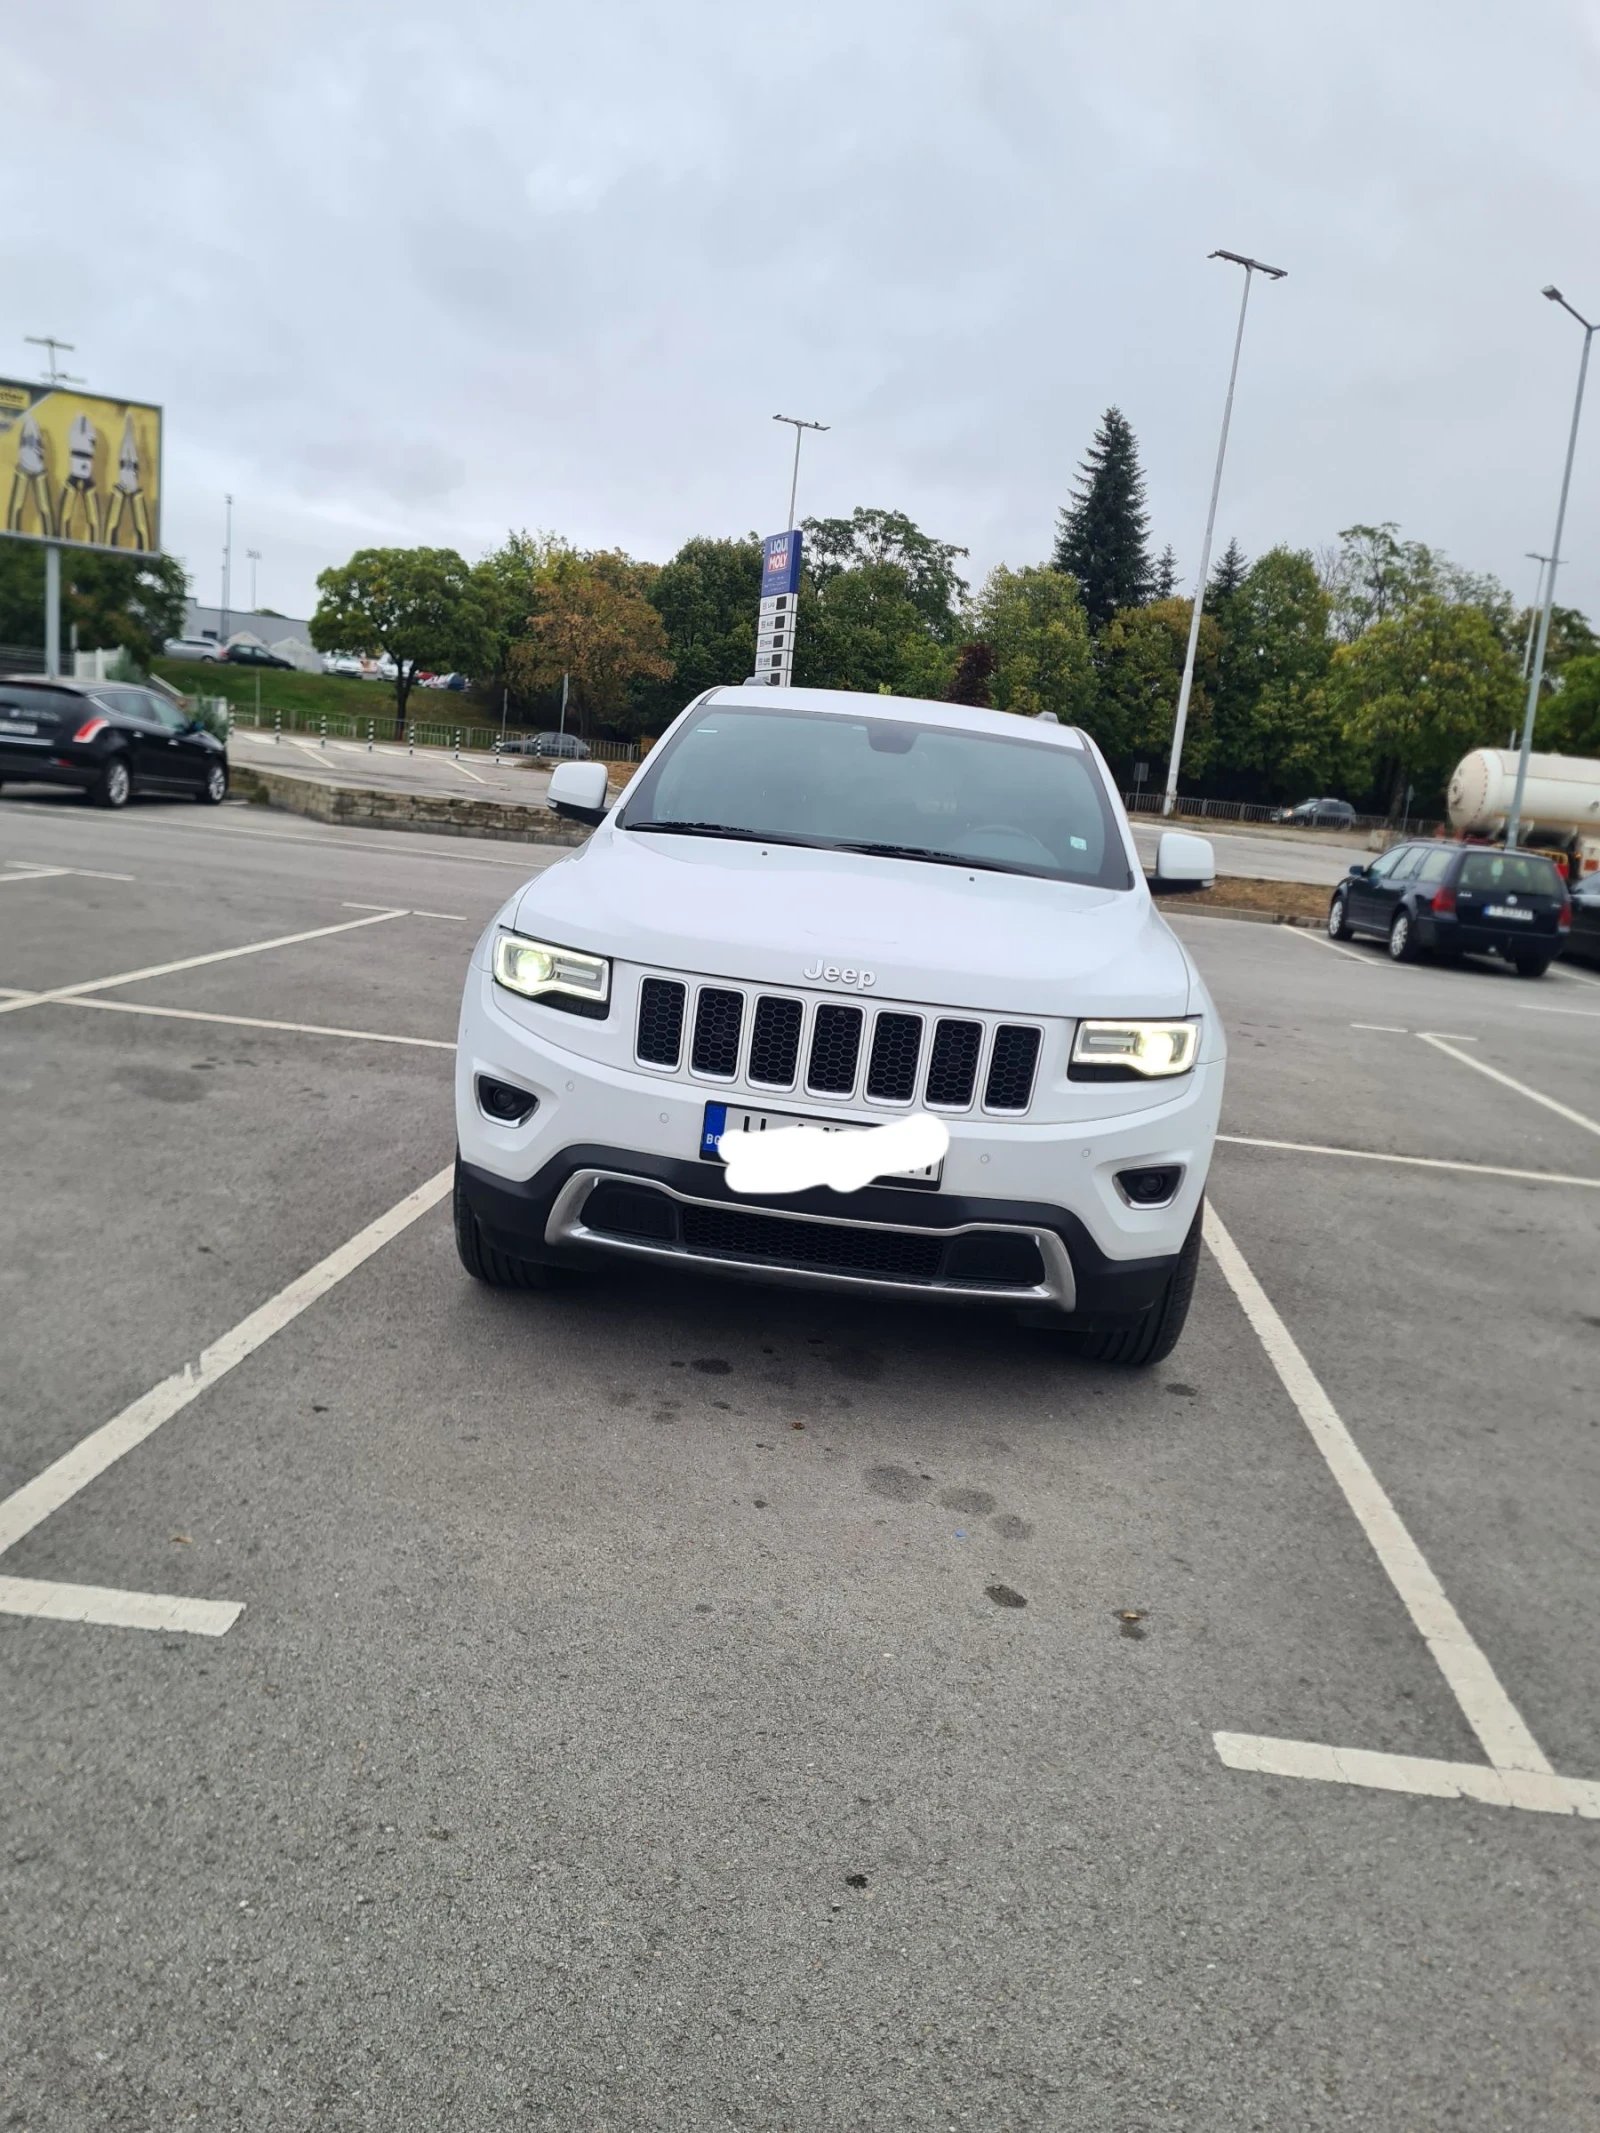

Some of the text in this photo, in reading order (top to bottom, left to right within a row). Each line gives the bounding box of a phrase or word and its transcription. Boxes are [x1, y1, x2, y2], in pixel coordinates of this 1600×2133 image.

[770, 537, 788, 554] LIQUI
[769, 553, 788, 570] MOLY
[803, 959, 876, 990] Jeep
